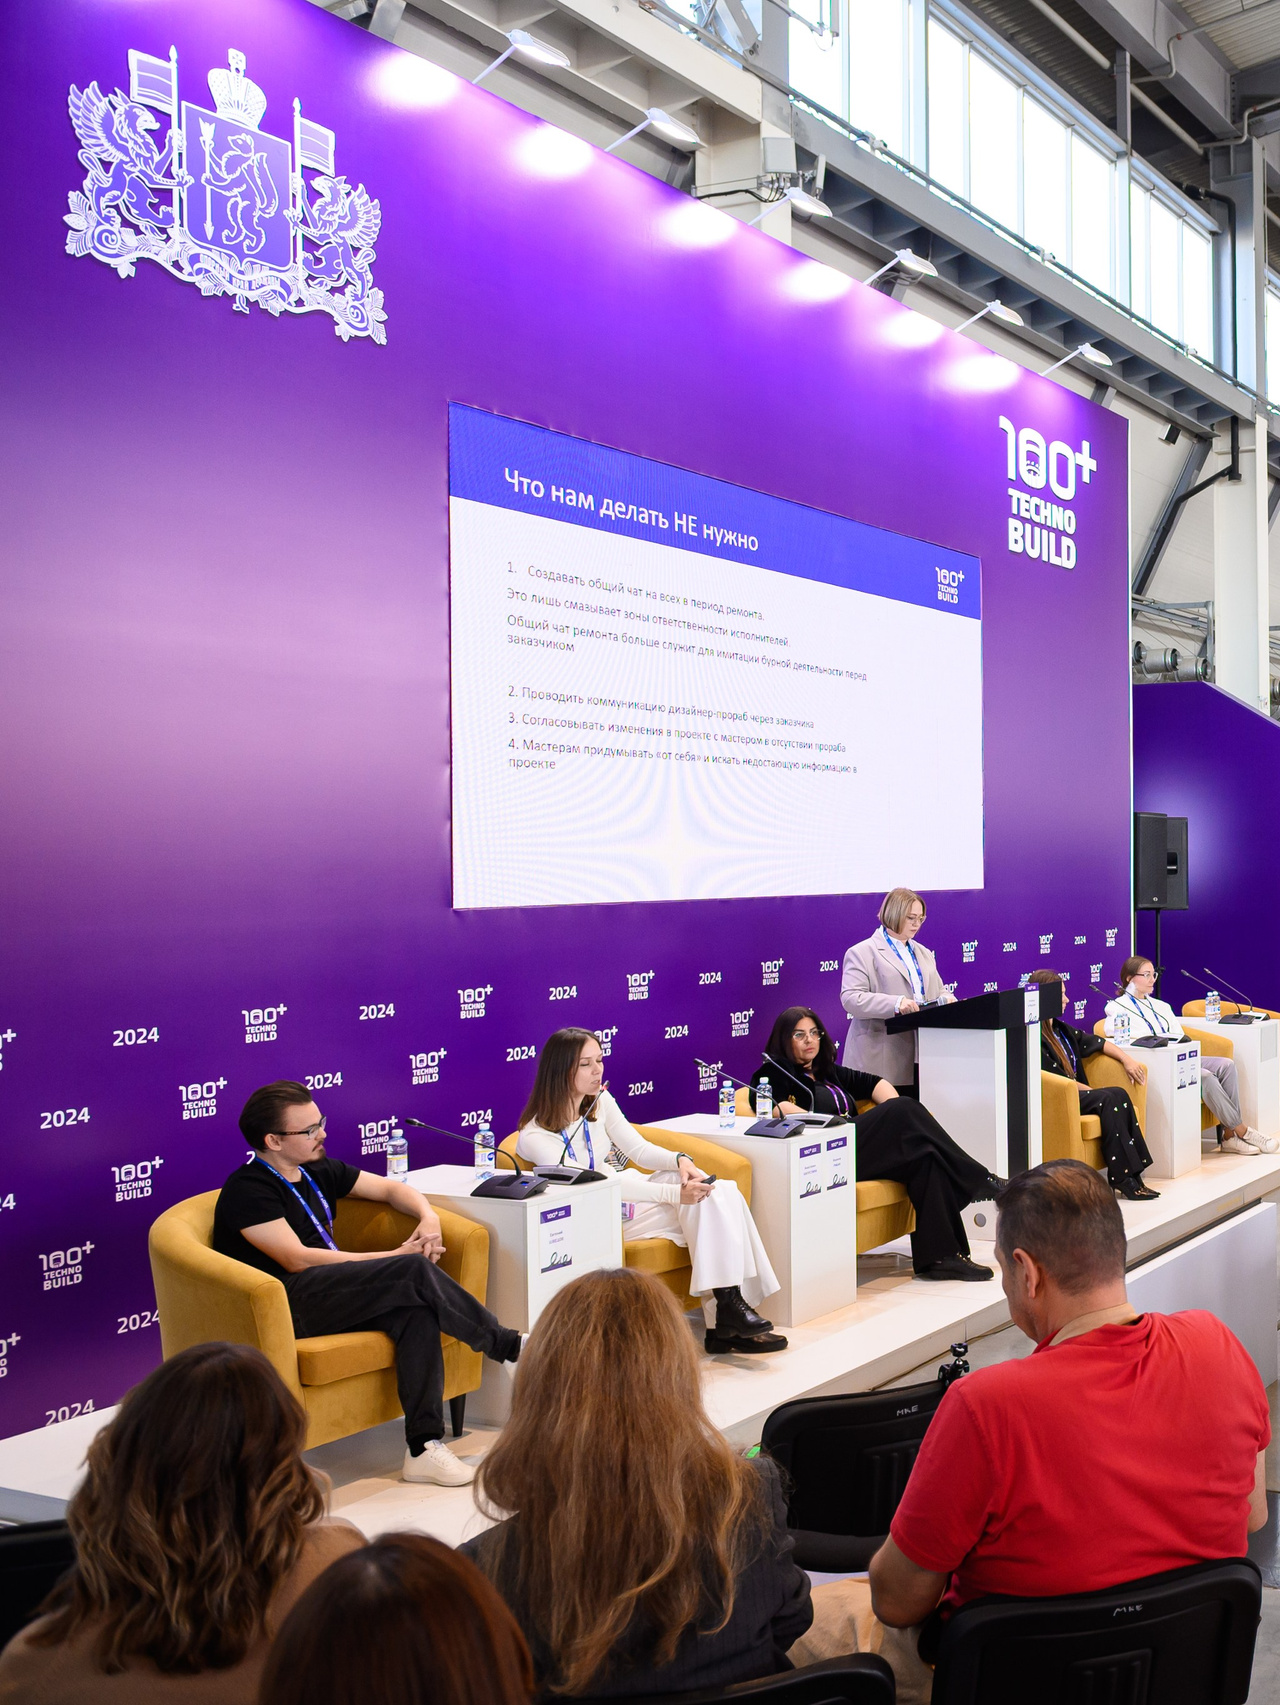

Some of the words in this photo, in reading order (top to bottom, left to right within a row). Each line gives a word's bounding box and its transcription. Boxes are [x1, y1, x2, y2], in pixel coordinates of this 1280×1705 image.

[998, 415, 1097, 501] 100+
[504, 467, 545, 499] Что
[551, 484, 595, 511] нам
[599, 498, 669, 530] делать
[673, 511, 698, 537] НЕ
[703, 523, 759, 552] нужно
[1007, 487, 1077, 535] TECHNO
[1007, 517, 1078, 570] BUILD
[935, 566, 965, 588] 100+
[507, 561, 517, 574] 1.
[528, 565, 586, 587] Создавать
[589, 578, 625, 594] общий
[627, 586, 643, 597] чат
[646, 590, 658, 600] на
[660, 594, 681, 605] всех
[683, 598, 689, 606] в
[691, 599, 725, 615] период
[726, 605, 765, 621] ремонта.
[937, 584, 958, 595] TECHNO
[937, 591, 959, 604] BUILD
[507, 588, 528, 602] Это
[531, 593, 562, 608] лишь
[564, 599, 622, 619] смазывает
[624, 611, 650, 623] зоны
[652, 615, 729, 637] ответственности
[507, 634, 575, 652] заказчиком
[507, 615, 550, 632] Общий
[552, 624, 570, 634] чат
[573, 627, 619, 643] ремонта
[621, 633, 660, 649] больше
[662, 640, 696, 655] служит
[697, 645, 715, 657] для
[716, 649, 760, 664] имитации
[761, 655, 792, 671] бурной
[793, 661, 844, 678] деятельности
[845, 669, 868, 682] перед
[508, 685, 519, 698] 2.
[522, 687, 584, 705] Проводить
[587, 696, 667, 714] коммуникацию
[668, 705, 749, 723] дизайнер-прораб
[750, 714, 775, 726] через
[775, 717, 815, 729] заказчика
[508, 712, 519, 725] 3.
[522, 713, 606, 732] Согласовывать
[608, 723, 664, 737] изменения
[667, 729, 672, 737] в
[674, 730, 712, 743] проекте
[714, 733, 719, 741] с
[721, 734, 763, 747] мастером
[765, 738, 770, 746] в
[771, 739, 814, 751] отсутствии
[815, 742, 847, 754] прораба
[508, 738, 519, 750] 4.
[523, 739, 581, 754] Мастерам
[583, 745, 654, 760] придумывать
[703, 754, 710, 763] и
[712, 755, 741, 766] искать
[742, 757, 801, 772] недостающую
[801, 762, 852, 774] информацию
[508, 758, 557, 771] проекте
[1003, 942, 1017, 953] 2024
[1074, 936, 1087, 945] 2024
[820, 960, 839, 972] 2024
[699, 971, 723, 985] 2024
[763, 978, 779, 986] BUILD
[549, 985, 578, 1001] 2024
[628, 986, 649, 994] TECHNO
[984, 982, 999, 993] 2024
[628, 992, 649, 1001] BUILD
[359, 1003, 396, 1021] 2024
[460, 1002, 486, 1011] TECHNO
[460, 1009, 486, 1020] BUILD
[245, 1024, 277, 1034] TECHNO
[664, 1025, 689, 1040] 2024
[731, 1028, 750, 1038] BUILD
[113, 1027, 160, 1047] 2024
[245, 1031, 278, 1044] BUILD
[506, 1045, 537, 1062] 2024
[412, 1066, 439, 1077] TECHNO
[304, 1072, 344, 1091] 2024
[412, 1074, 439, 1086] BUILD
[699, 1082, 718, 1092] BUILD
[628, 1081, 655, 1097] 2024
[182, 1098, 217, 1110] TECHNO
[40, 1107, 91, 1130] 2024
[182, 1106, 217, 1121] BUILD
[461, 1108, 494, 1127] 2024
[361, 1135, 390, 1147] TECHNO
[361, 1142, 389, 1156] BUILD
[115, 1178, 152, 1193] TECHNO
[115, 1186, 152, 1203] BUILD
[43, 1265, 83, 1281] TECHNO
[43, 1273, 83, 1292] BUILD
[117, 1309, 161, 1335] 2024
[45, 1399, 96, 1428] 2024
